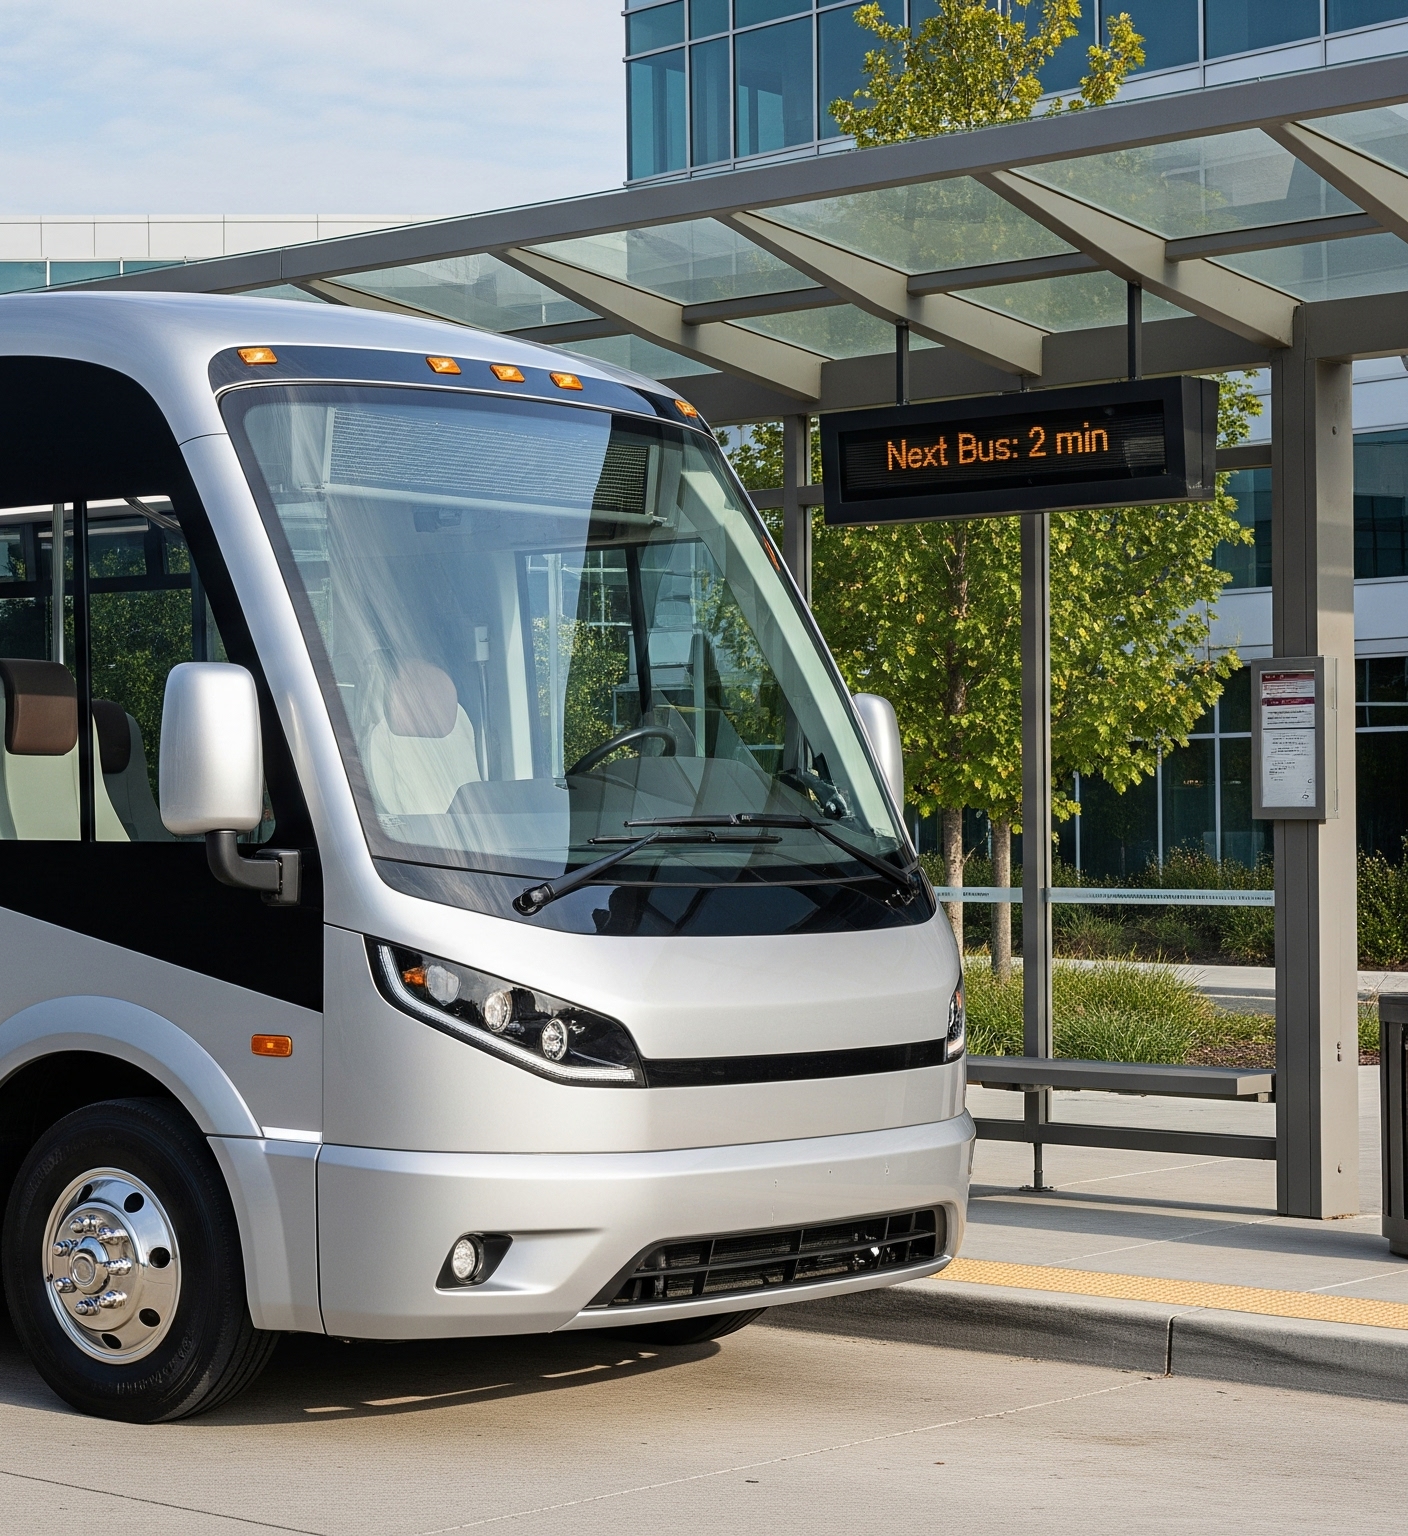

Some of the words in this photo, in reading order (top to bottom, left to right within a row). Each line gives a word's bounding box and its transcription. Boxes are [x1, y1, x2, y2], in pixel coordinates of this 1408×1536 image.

[887, 436, 949, 471] Next
[958, 432, 1019, 465] Bus:
[1028, 426, 1047, 459] 2
[1055, 422, 1109, 455] min
